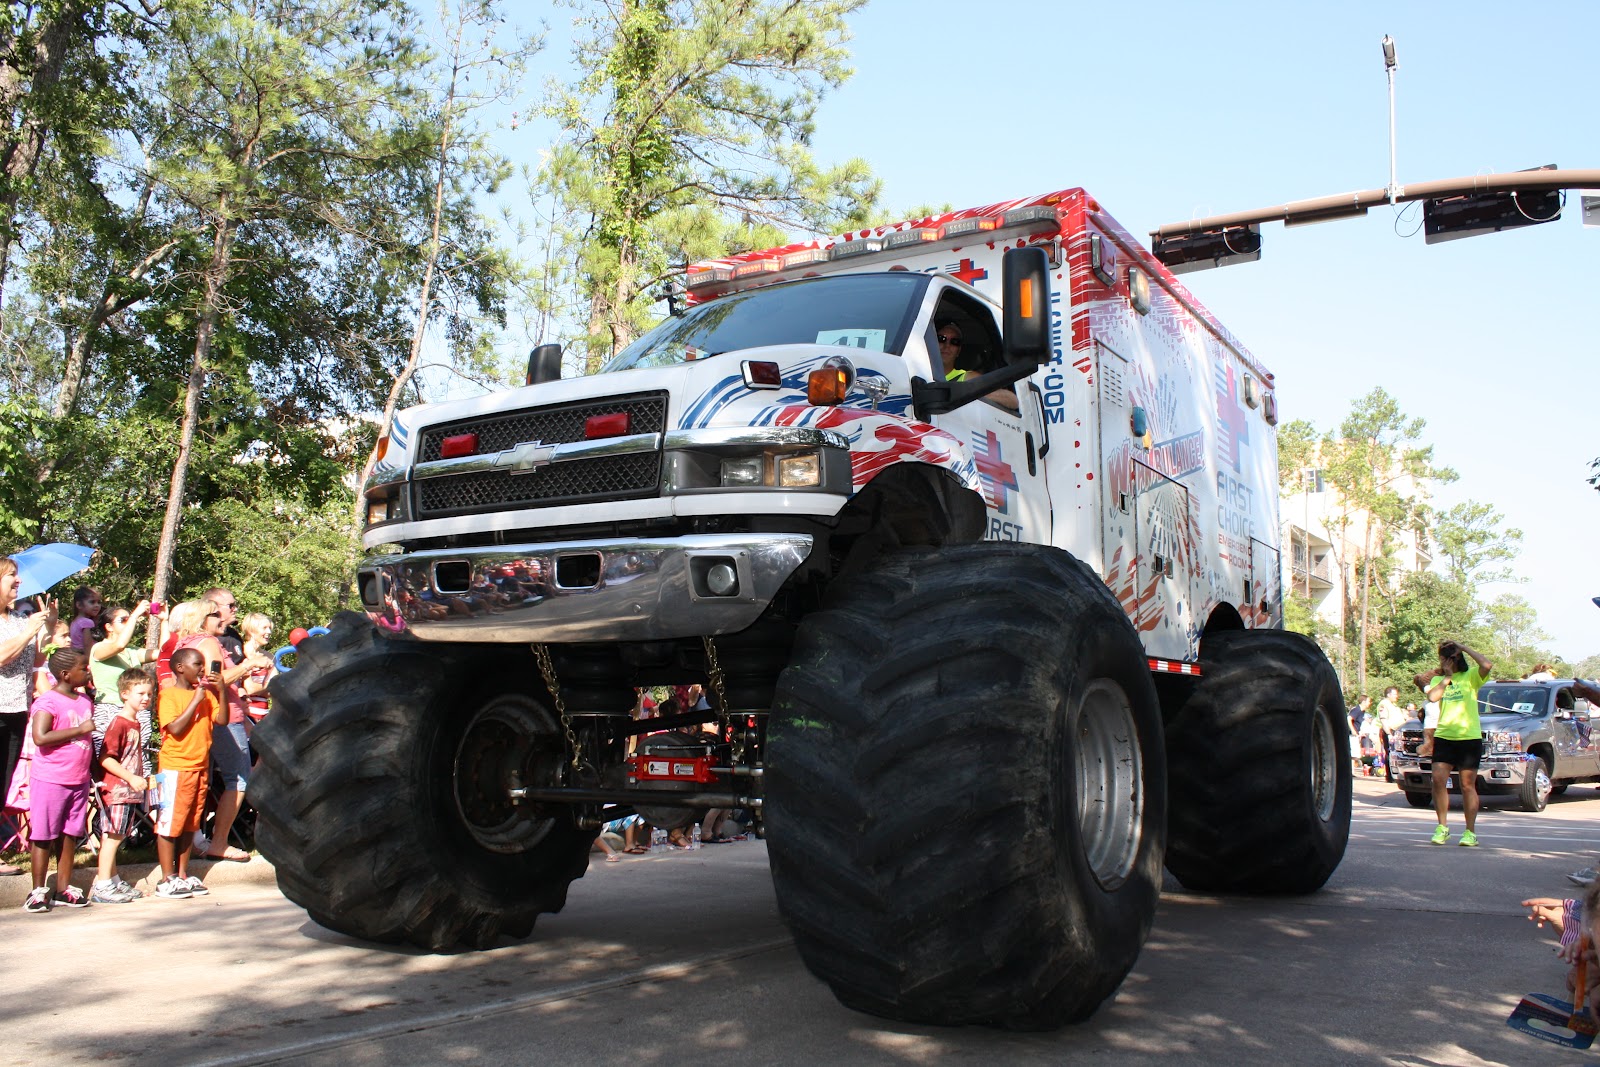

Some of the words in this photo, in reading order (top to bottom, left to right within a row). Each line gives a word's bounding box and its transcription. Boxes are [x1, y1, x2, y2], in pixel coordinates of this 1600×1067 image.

[1216, 470, 1254, 515] FIRST
[985, 516, 1024, 542] IRST
[1217, 504, 1256, 541] CHOICE
[1228, 553, 1248, 570] ROOM
